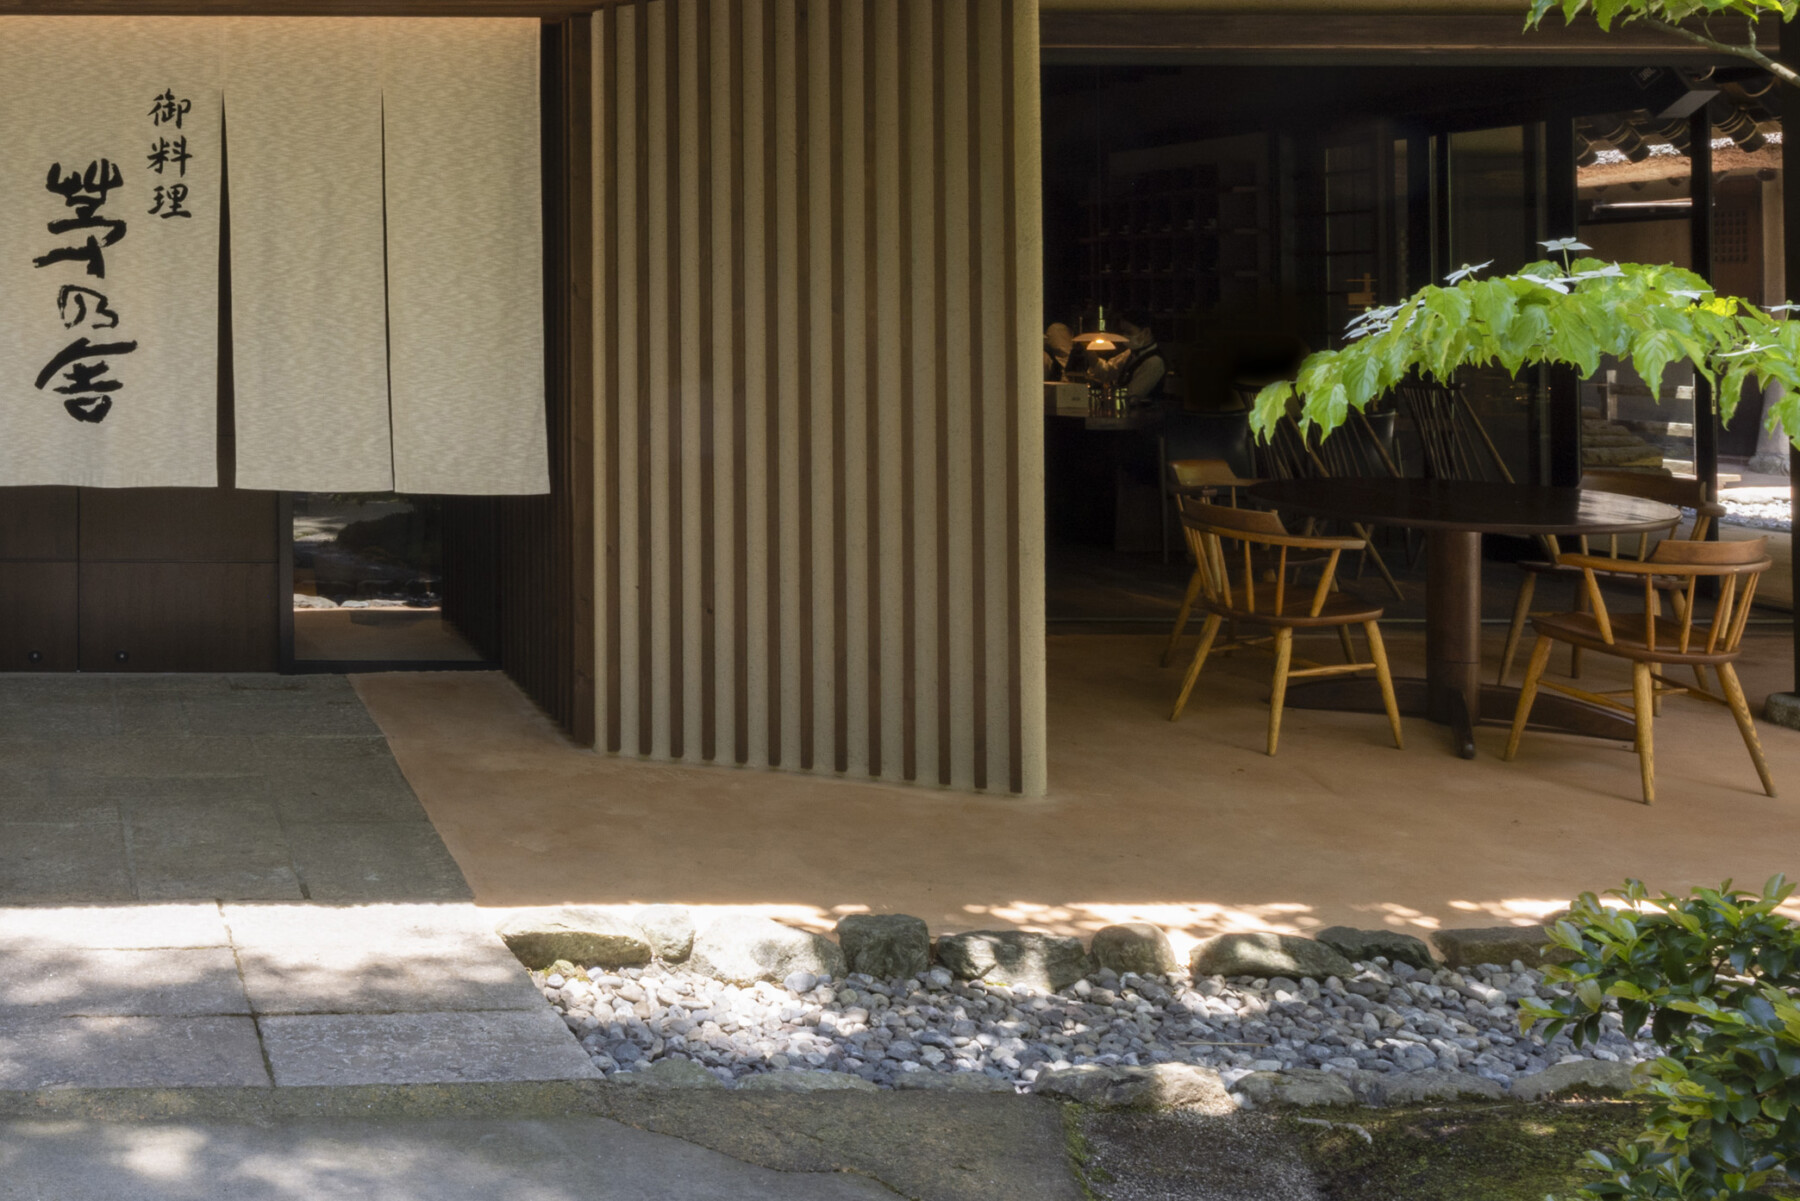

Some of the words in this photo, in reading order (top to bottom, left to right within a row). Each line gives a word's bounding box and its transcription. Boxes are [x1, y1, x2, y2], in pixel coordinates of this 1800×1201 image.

[1638, 67, 1657, 81] JBL
[147, 88, 193, 220] 御料理
